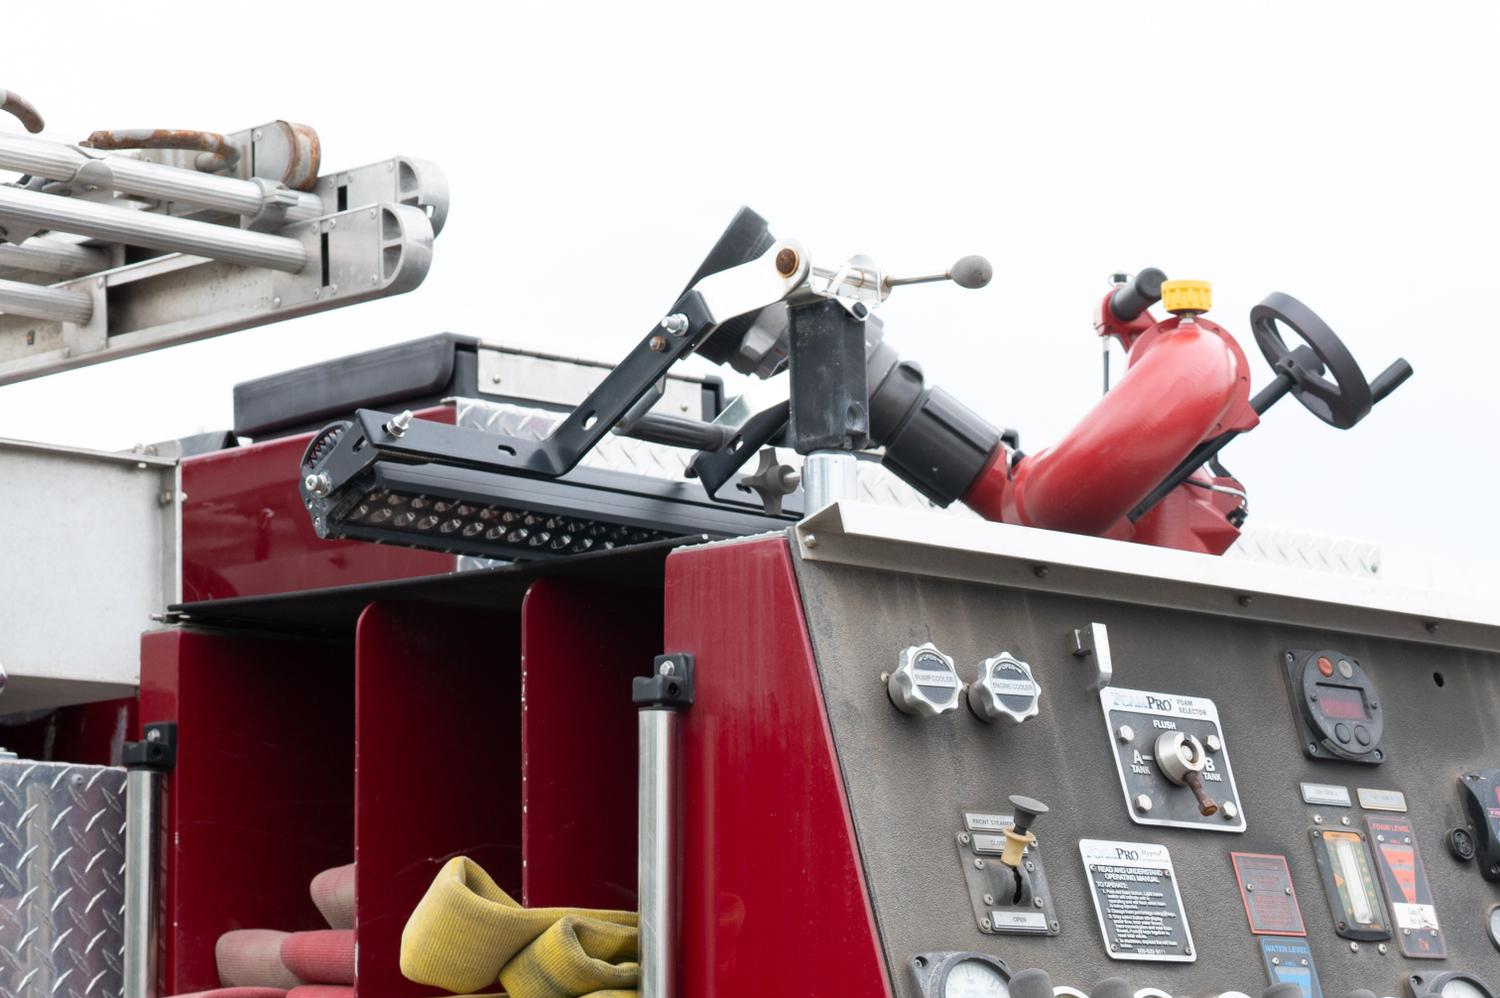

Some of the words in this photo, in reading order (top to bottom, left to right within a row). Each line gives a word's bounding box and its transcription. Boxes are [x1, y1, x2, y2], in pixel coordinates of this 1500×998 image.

[1178, 706, 1207, 716] SELECTOR
[1152, 719, 1177, 730] FLUSH
[1133, 749, 1144, 764] A
[1204, 757, 1215, 771] B
[1131, 764, 1151, 775] TANK
[1202, 771, 1222, 782] TANK
[972, 818, 989, 826] FRONT
[1126, 868, 1163, 876] UNDERSTAND
[1104, 873, 1136, 881] OPERATING
[1136, 875, 1160, 883] MANUAL
[1264, 944, 1287, 953] WATER
[1287, 945, 1308, 954] LEVEL
